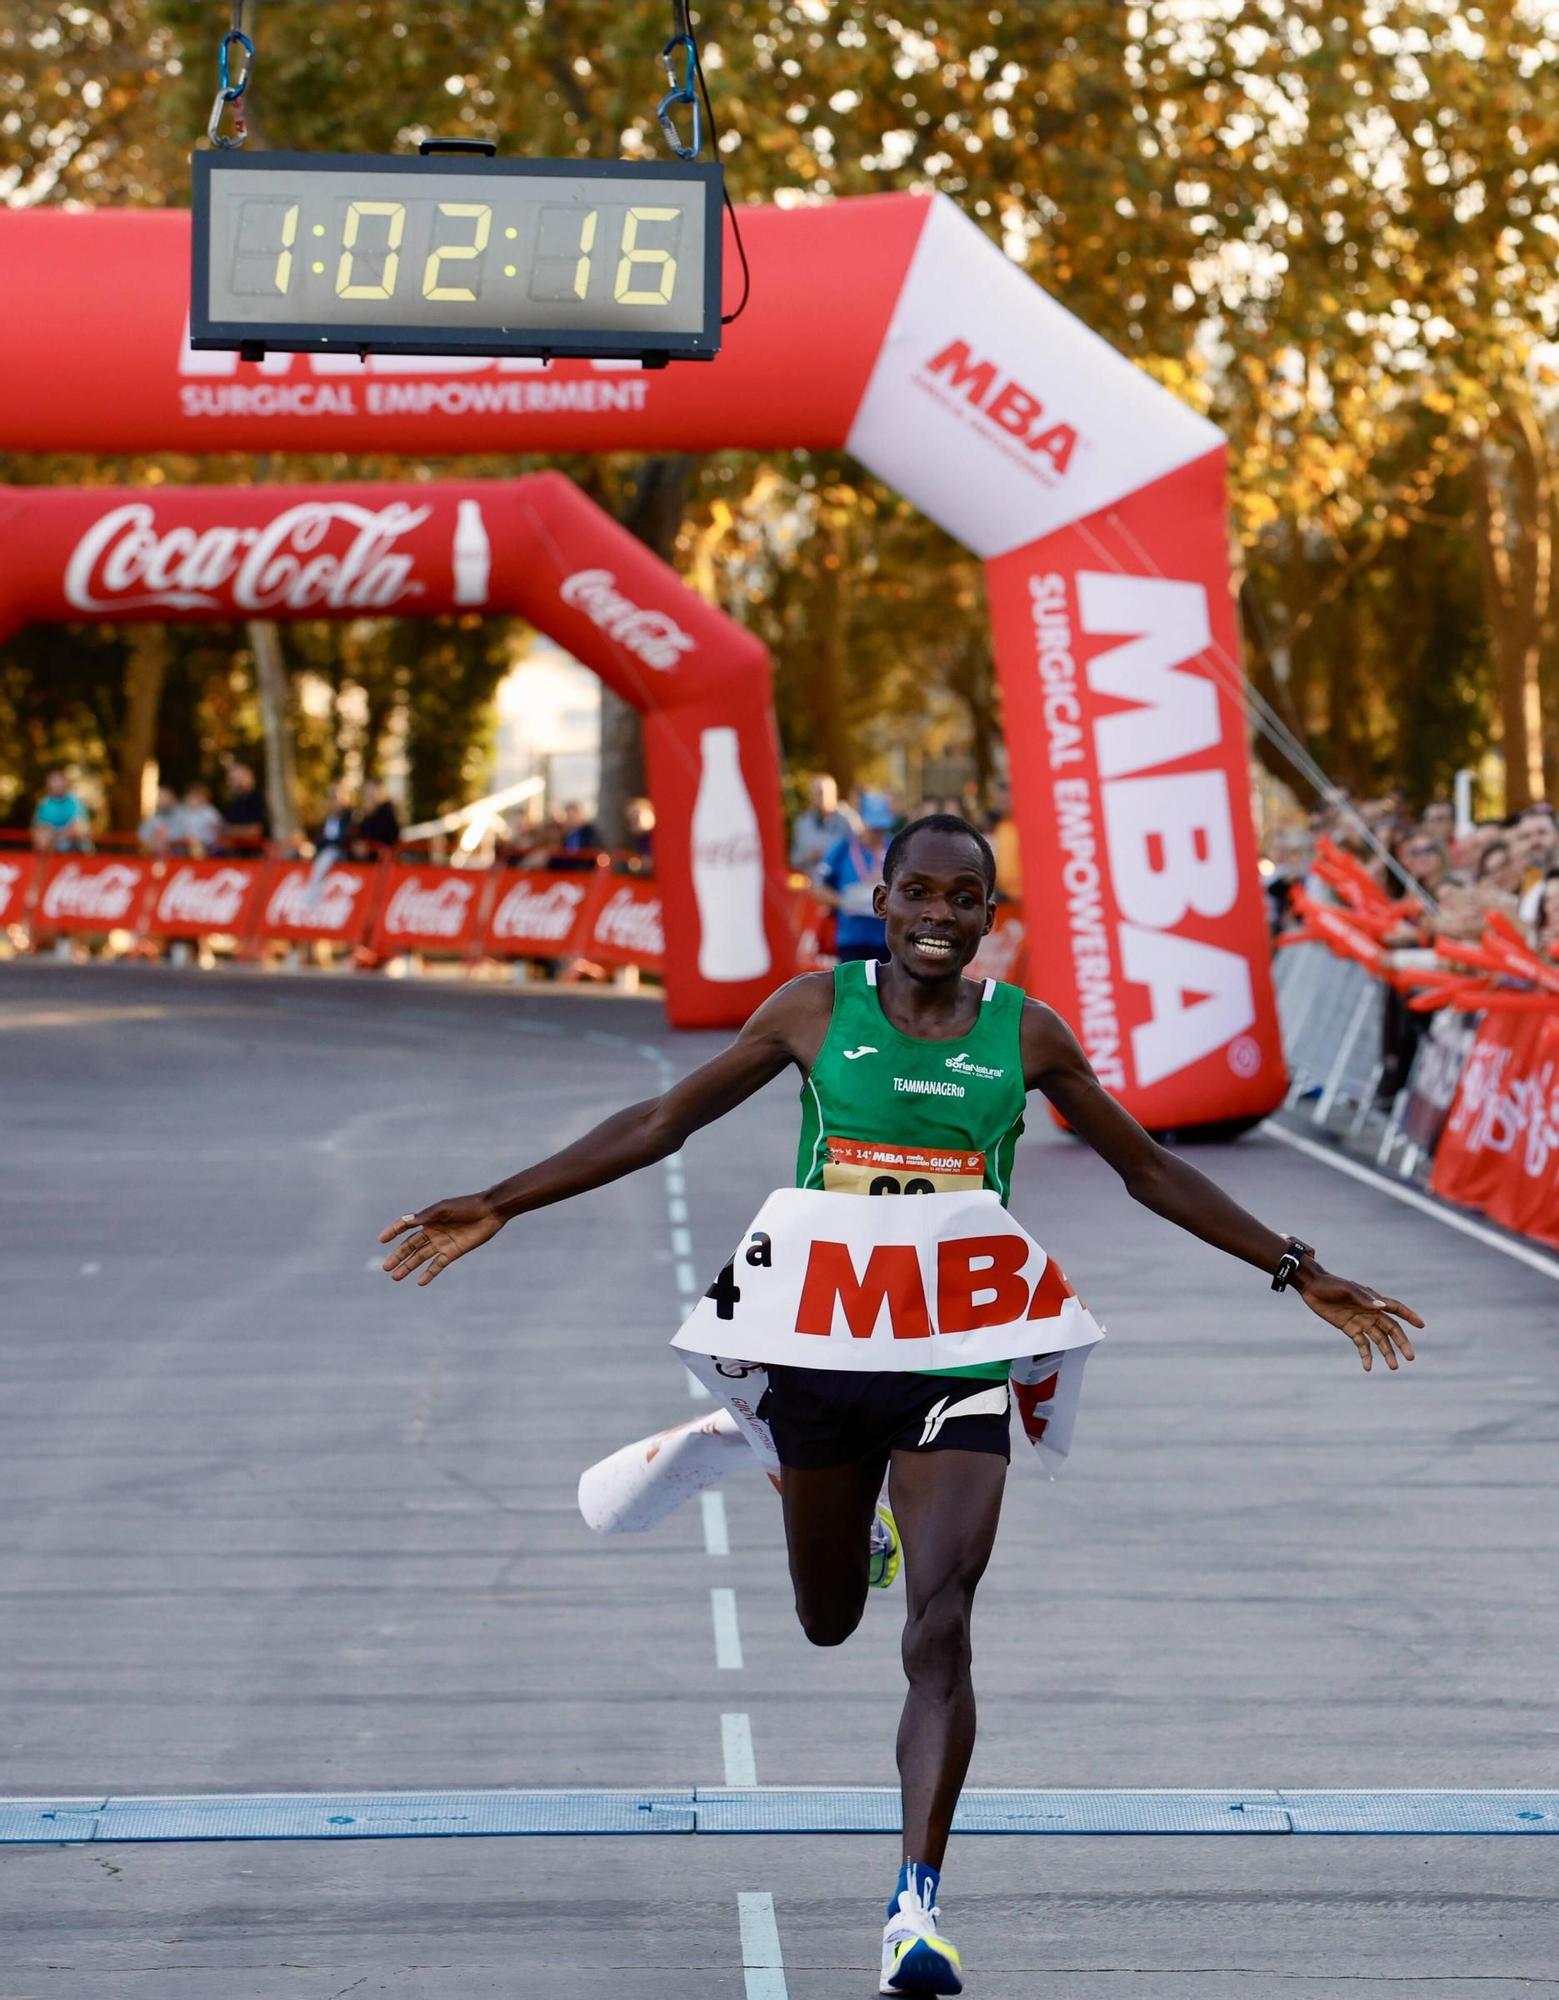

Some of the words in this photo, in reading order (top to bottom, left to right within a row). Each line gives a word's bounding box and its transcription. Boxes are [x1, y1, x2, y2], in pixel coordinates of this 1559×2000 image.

[274, 201, 682, 305] 1:02:16
[181, 383, 356, 416] SURGICAL
[366, 380, 650, 415] EMPOWERMENT
[926, 338, 1078, 476] MBA
[64, 502, 434, 612] Coca-Cola
[1028, 573, 1084, 771] SURGICAL
[1076, 569, 1255, 1088] MBA
[872, 1151, 904, 1164] MBA
[930, 1156, 962, 1168] GIJÓN
